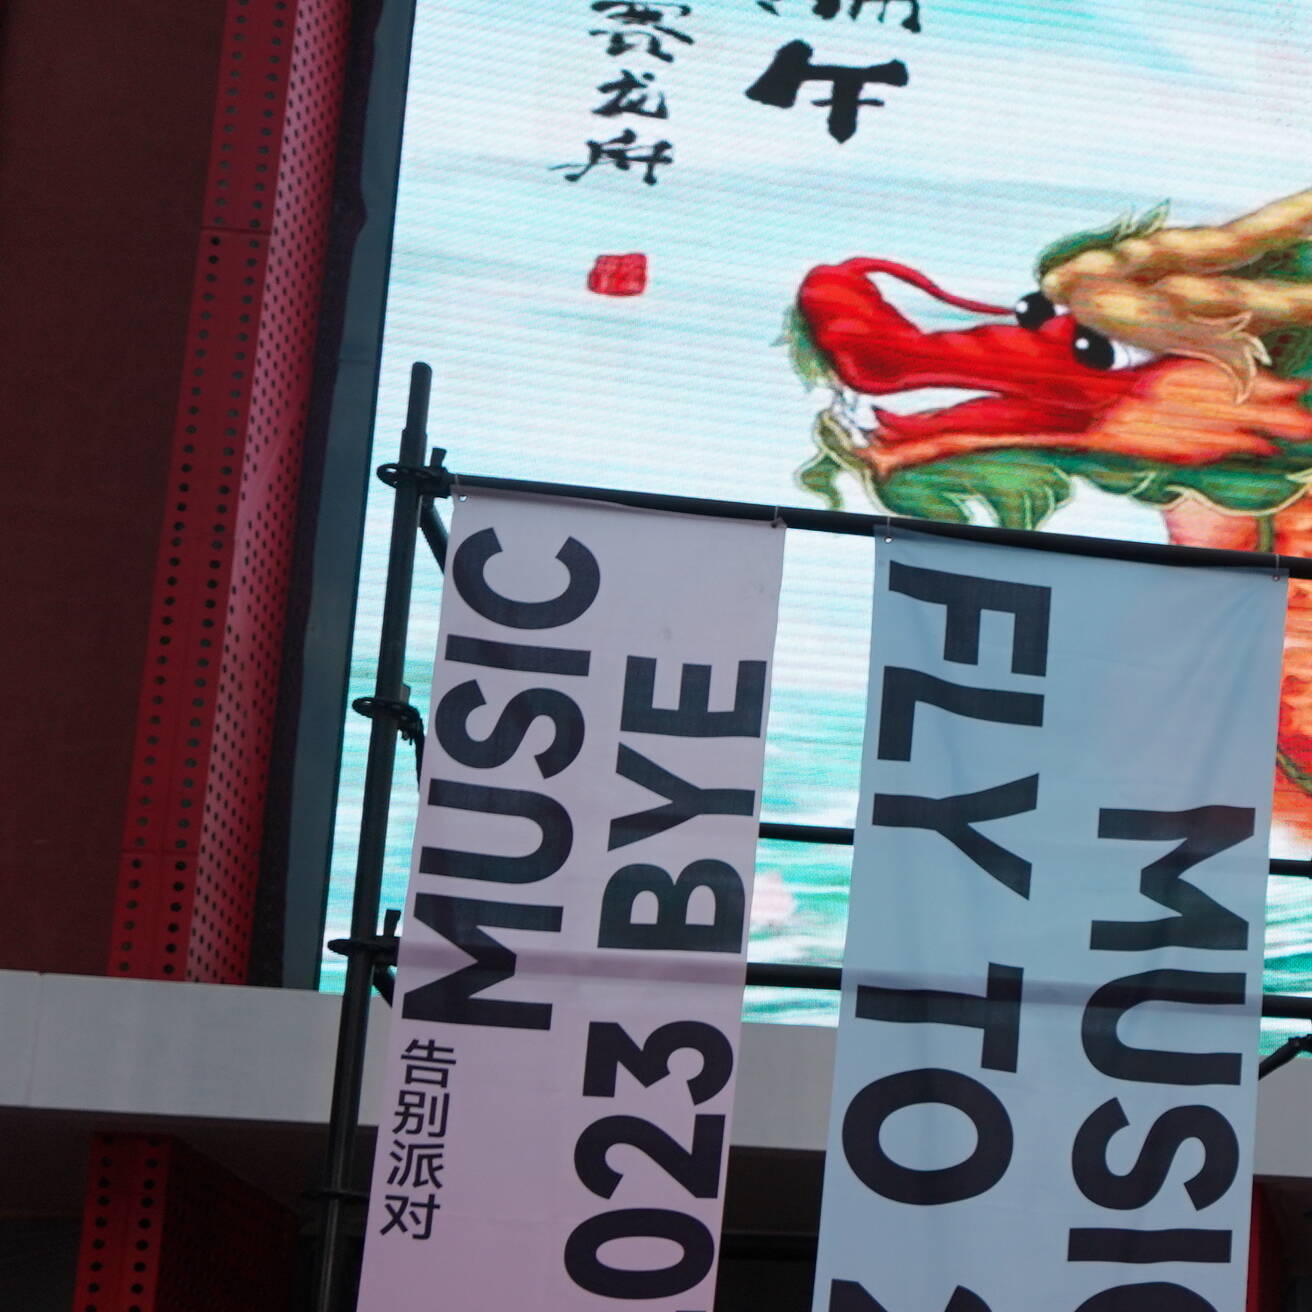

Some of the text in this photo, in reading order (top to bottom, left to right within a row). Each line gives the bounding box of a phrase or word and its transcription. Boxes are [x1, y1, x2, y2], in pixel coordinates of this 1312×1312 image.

[401, 527, 601, 1032] MUSIC
[597, 655, 768, 954] BYE
[871, 560, 1053, 901] FLY
[379, 1038, 458, 1241] 告别派对
[841, 962, 1025, 1206] TO
